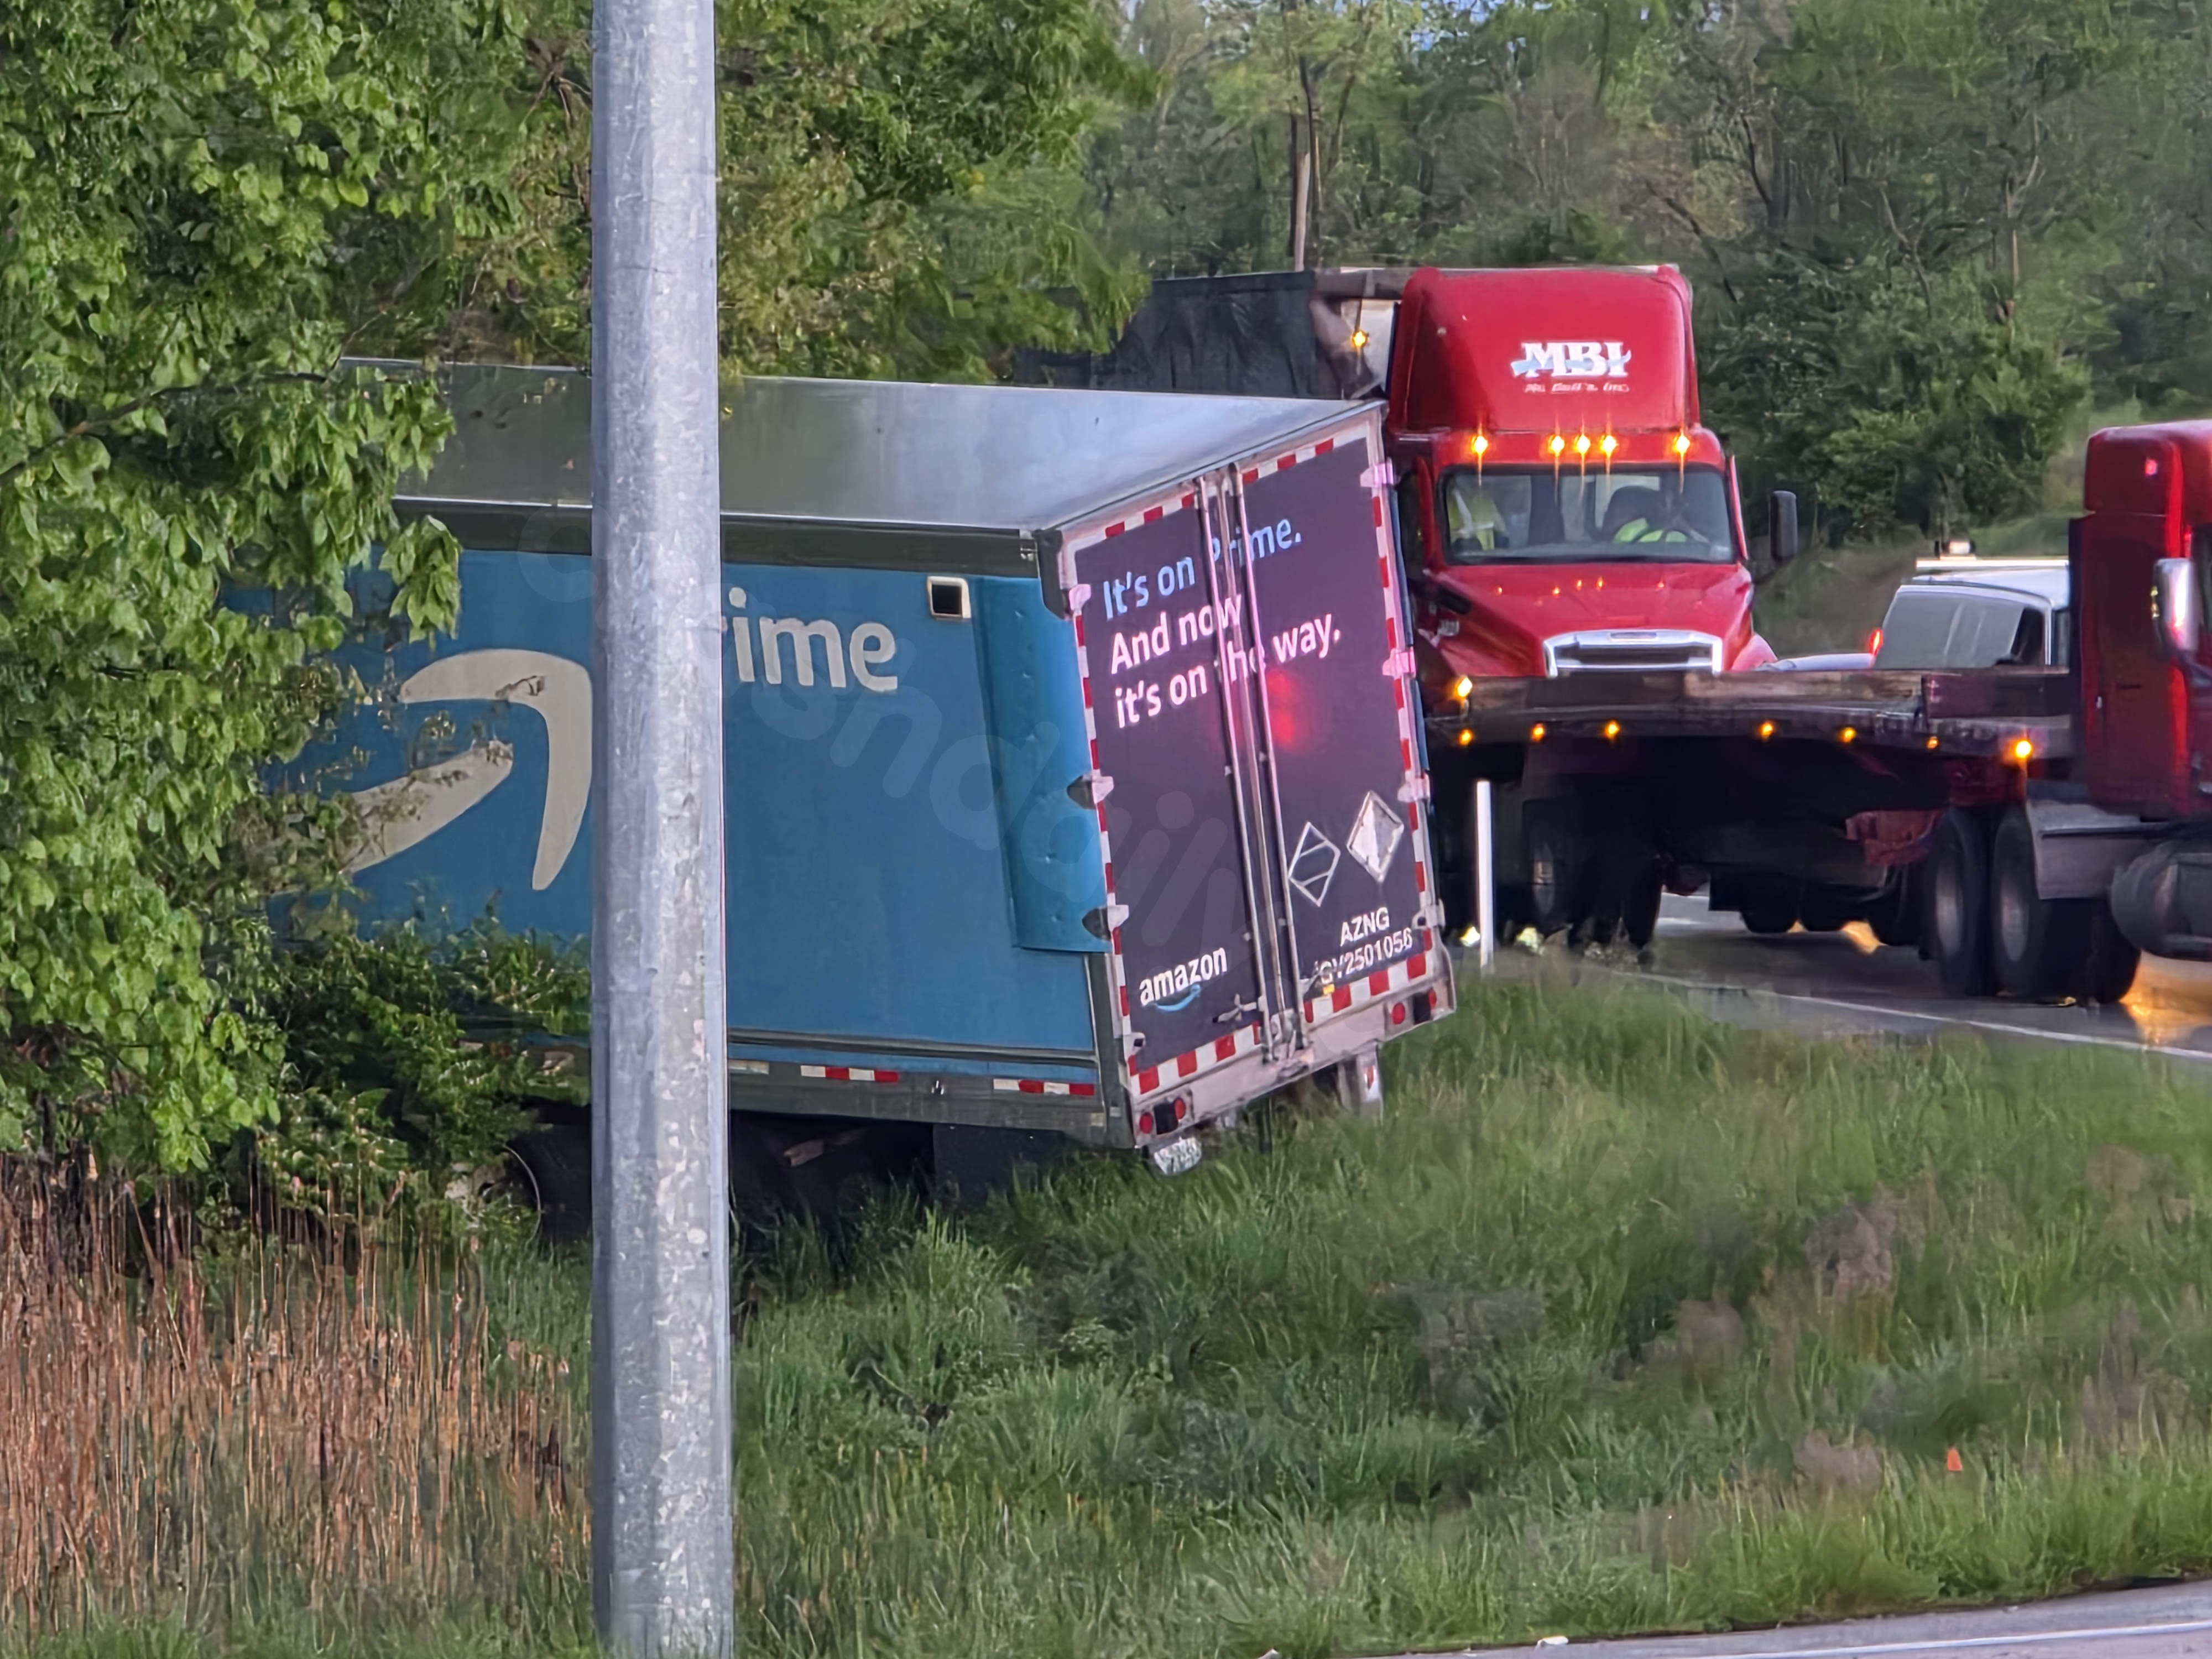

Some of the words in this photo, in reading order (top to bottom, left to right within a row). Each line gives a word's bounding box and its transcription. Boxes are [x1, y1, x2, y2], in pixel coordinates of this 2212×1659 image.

[1519, 341, 1628, 377] MBI
[1103, 572, 1149, 619] It's
[1157, 557, 1195, 596] on
[721, 587, 898, 692] ime
[1111, 612, 1170, 675] And
[1178, 594, 1241, 646] now
[1115, 680, 1161, 728] it's
[1170, 665, 1208, 705] on
[1214, 640, 1267, 682] he
[1272, 614, 1340, 662] way.
[1340, 907, 1390, 947] AZNG
[1139, 947, 1227, 1006] amazon
